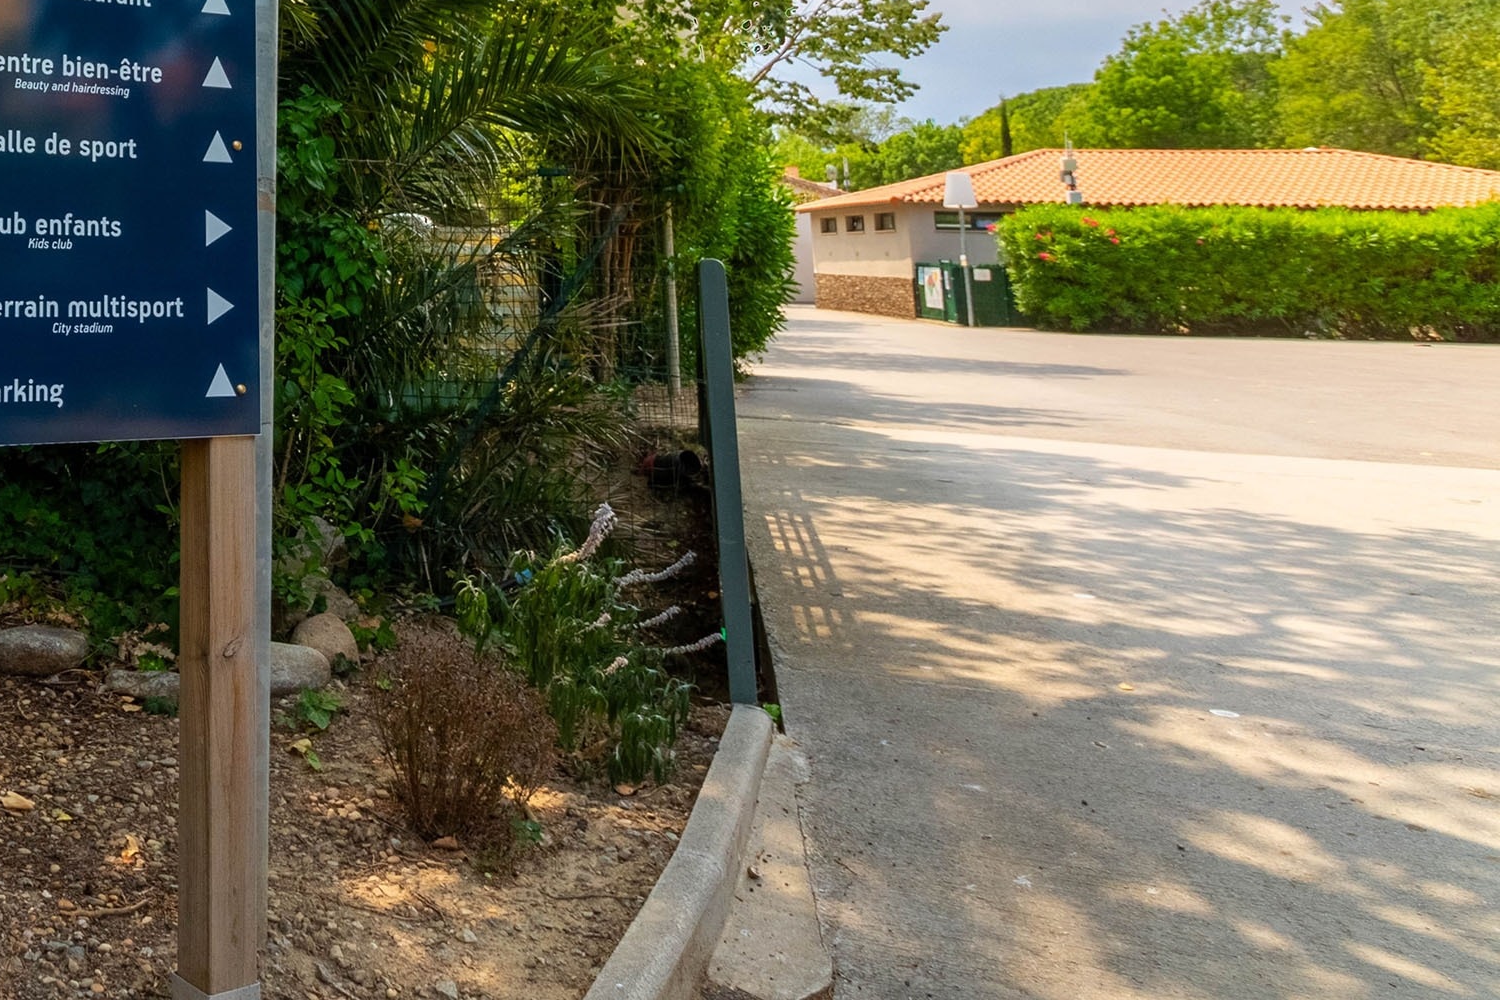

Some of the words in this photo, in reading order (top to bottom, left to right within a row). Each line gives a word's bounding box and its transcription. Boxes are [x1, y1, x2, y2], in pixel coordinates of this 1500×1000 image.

[62, 54, 162, 84] bien-être
[15, 79, 49, 93] Beauty
[51, 81, 70, 92] and
[72, 82, 130, 99] hairdressing
[45, 132, 71, 155] de
[79, 139, 137, 162] sport
[36, 213, 121, 237] enfants
[28, 238, 49, 249] Kids
[52, 238, 72, 249] club
[68, 295, 184, 323] multisport
[52, 322, 72, 336] City
[74, 322, 113, 333] stadium
